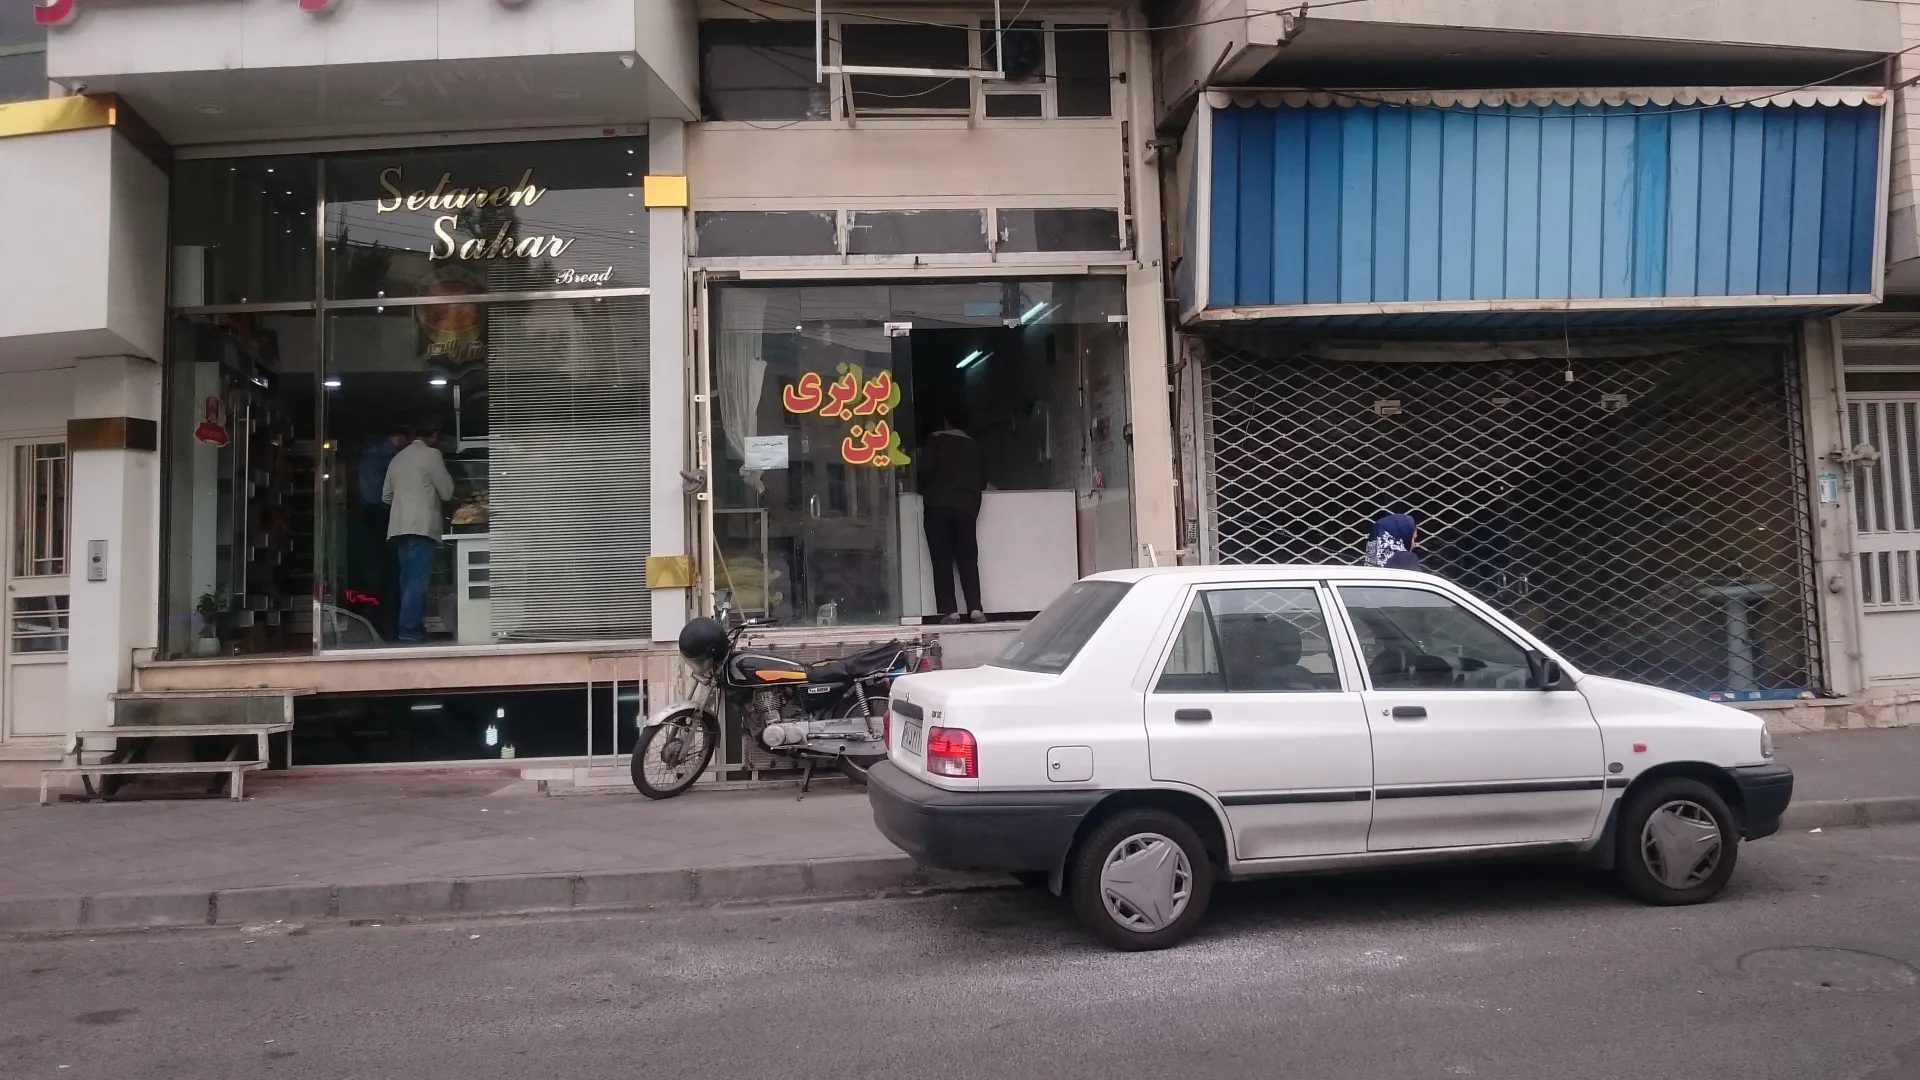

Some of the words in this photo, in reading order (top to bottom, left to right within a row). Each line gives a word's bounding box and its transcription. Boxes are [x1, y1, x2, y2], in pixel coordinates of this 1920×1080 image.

[377, 166, 547, 214] Setareh
[429, 214, 576, 262] Sahar
[555, 266, 613, 285] Bread
[783, 372, 892, 421] بربری
